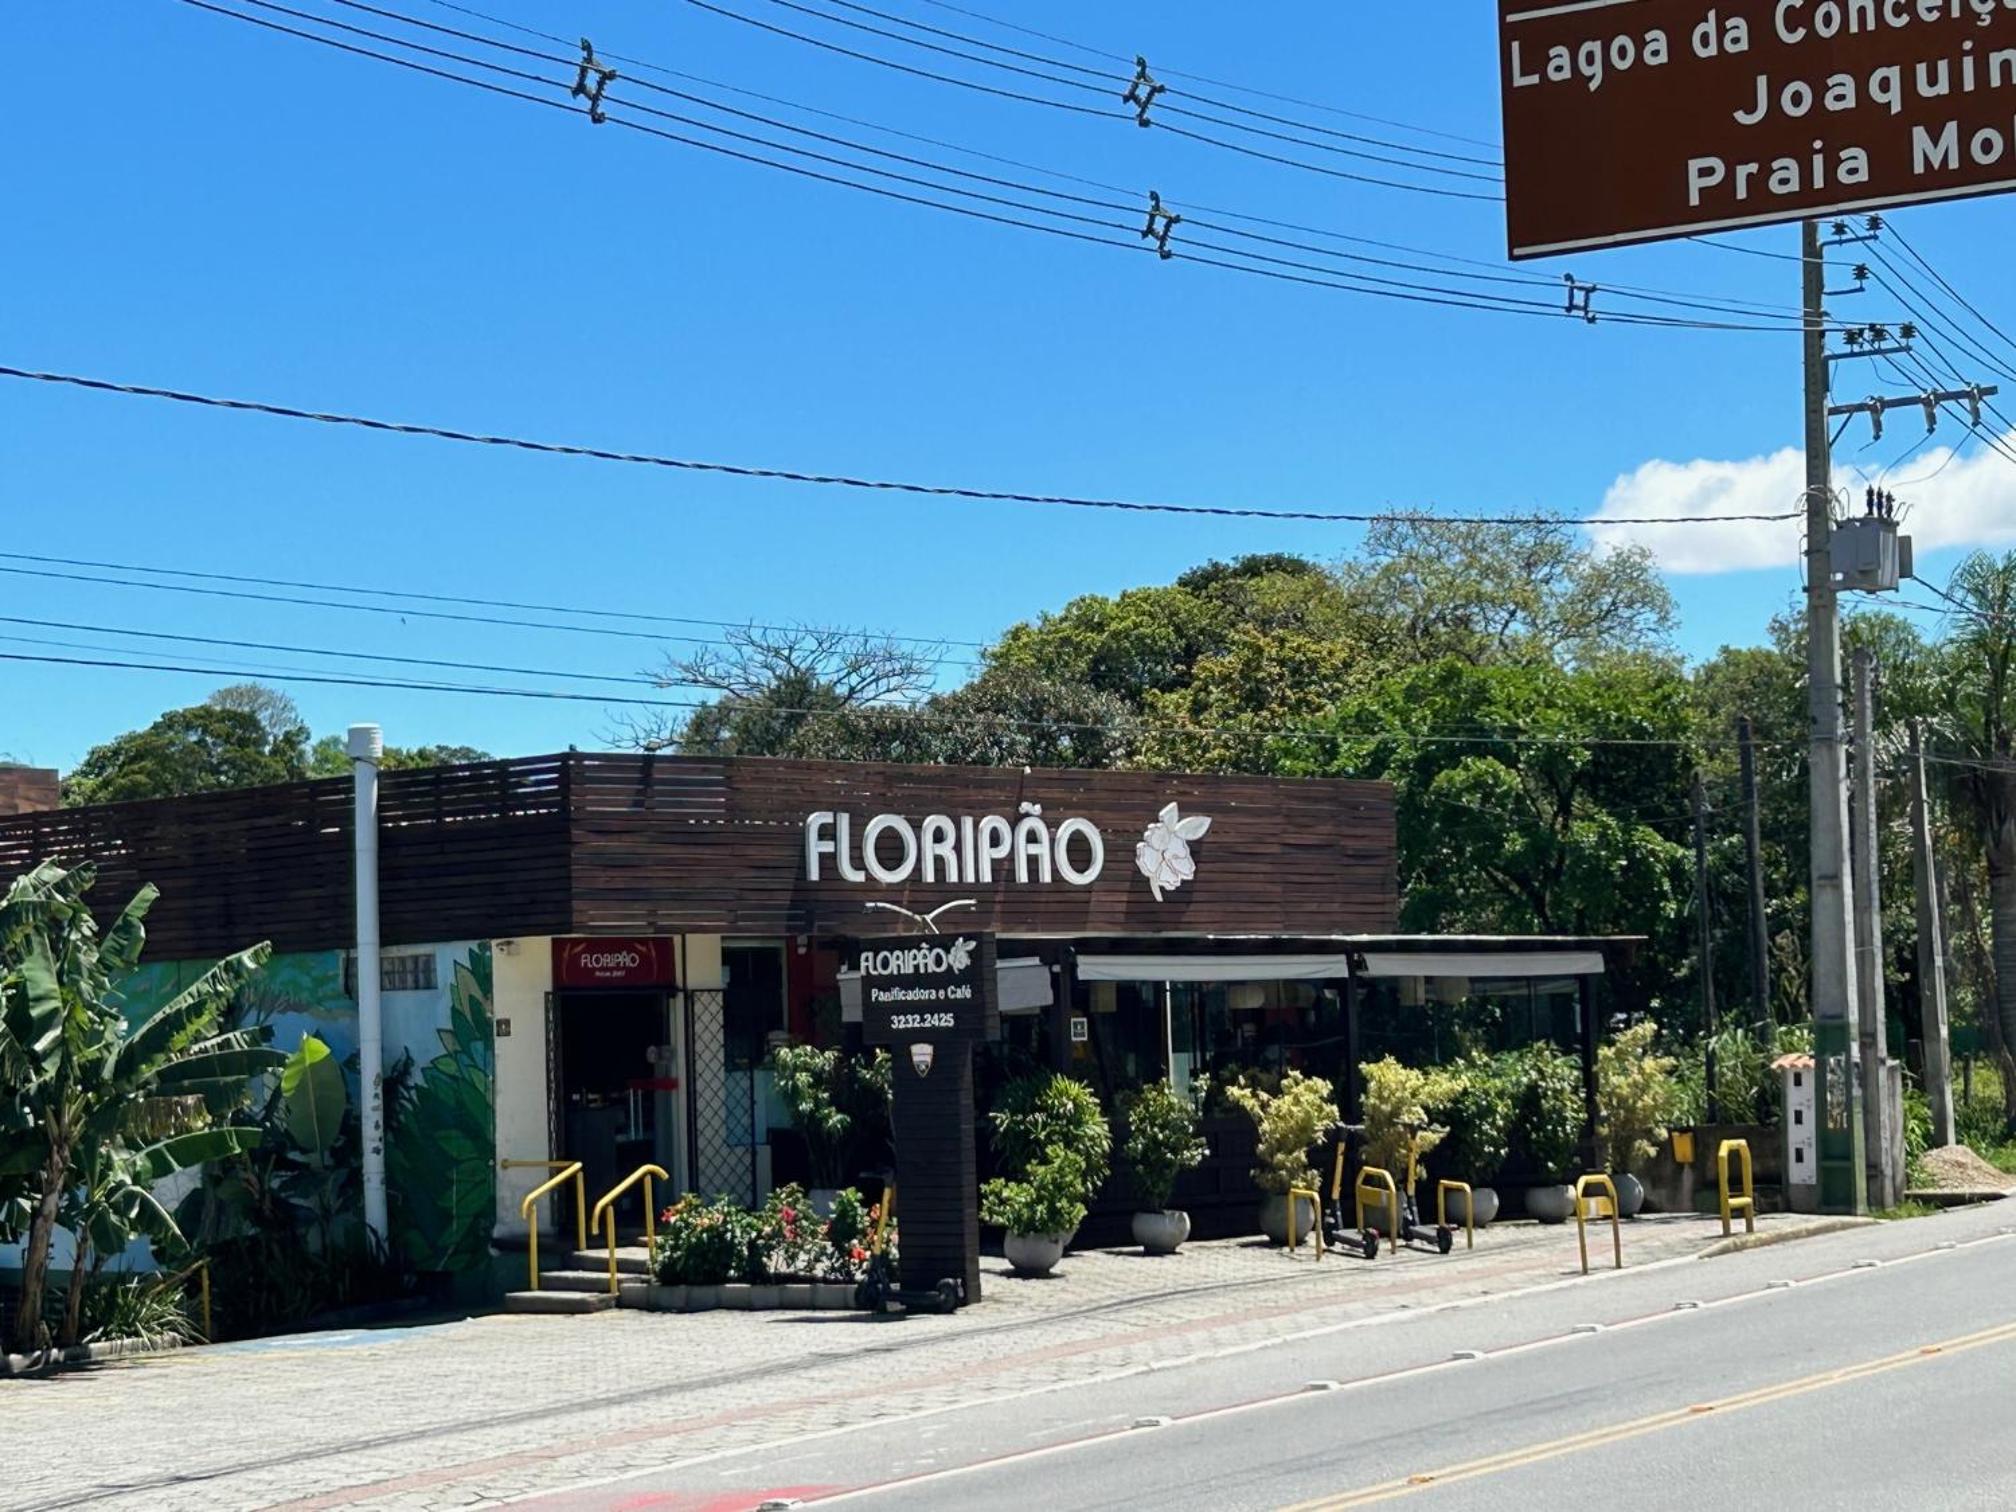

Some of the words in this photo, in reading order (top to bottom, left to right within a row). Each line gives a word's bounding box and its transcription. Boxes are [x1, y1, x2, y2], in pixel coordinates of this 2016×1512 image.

[1511, 29, 1669, 92] Lagoa
[1691, 9, 1749, 59] da
[1774, 0, 2016, 44] Conceç
[1688, 139, 1870, 206] Praia
[1912, 120, 2016, 174] Mo
[806, 801, 1105, 886] FLORIPÃO
[581, 950, 640, 968] FLORIPÃO
[860, 942, 948, 976] FLORIPÃO
[871, 987, 937, 1002] Panificadora
[938, 988, 946, 999] e
[947, 984, 972, 999] Café
[890, 1013, 955, 1029] 3232.2425
